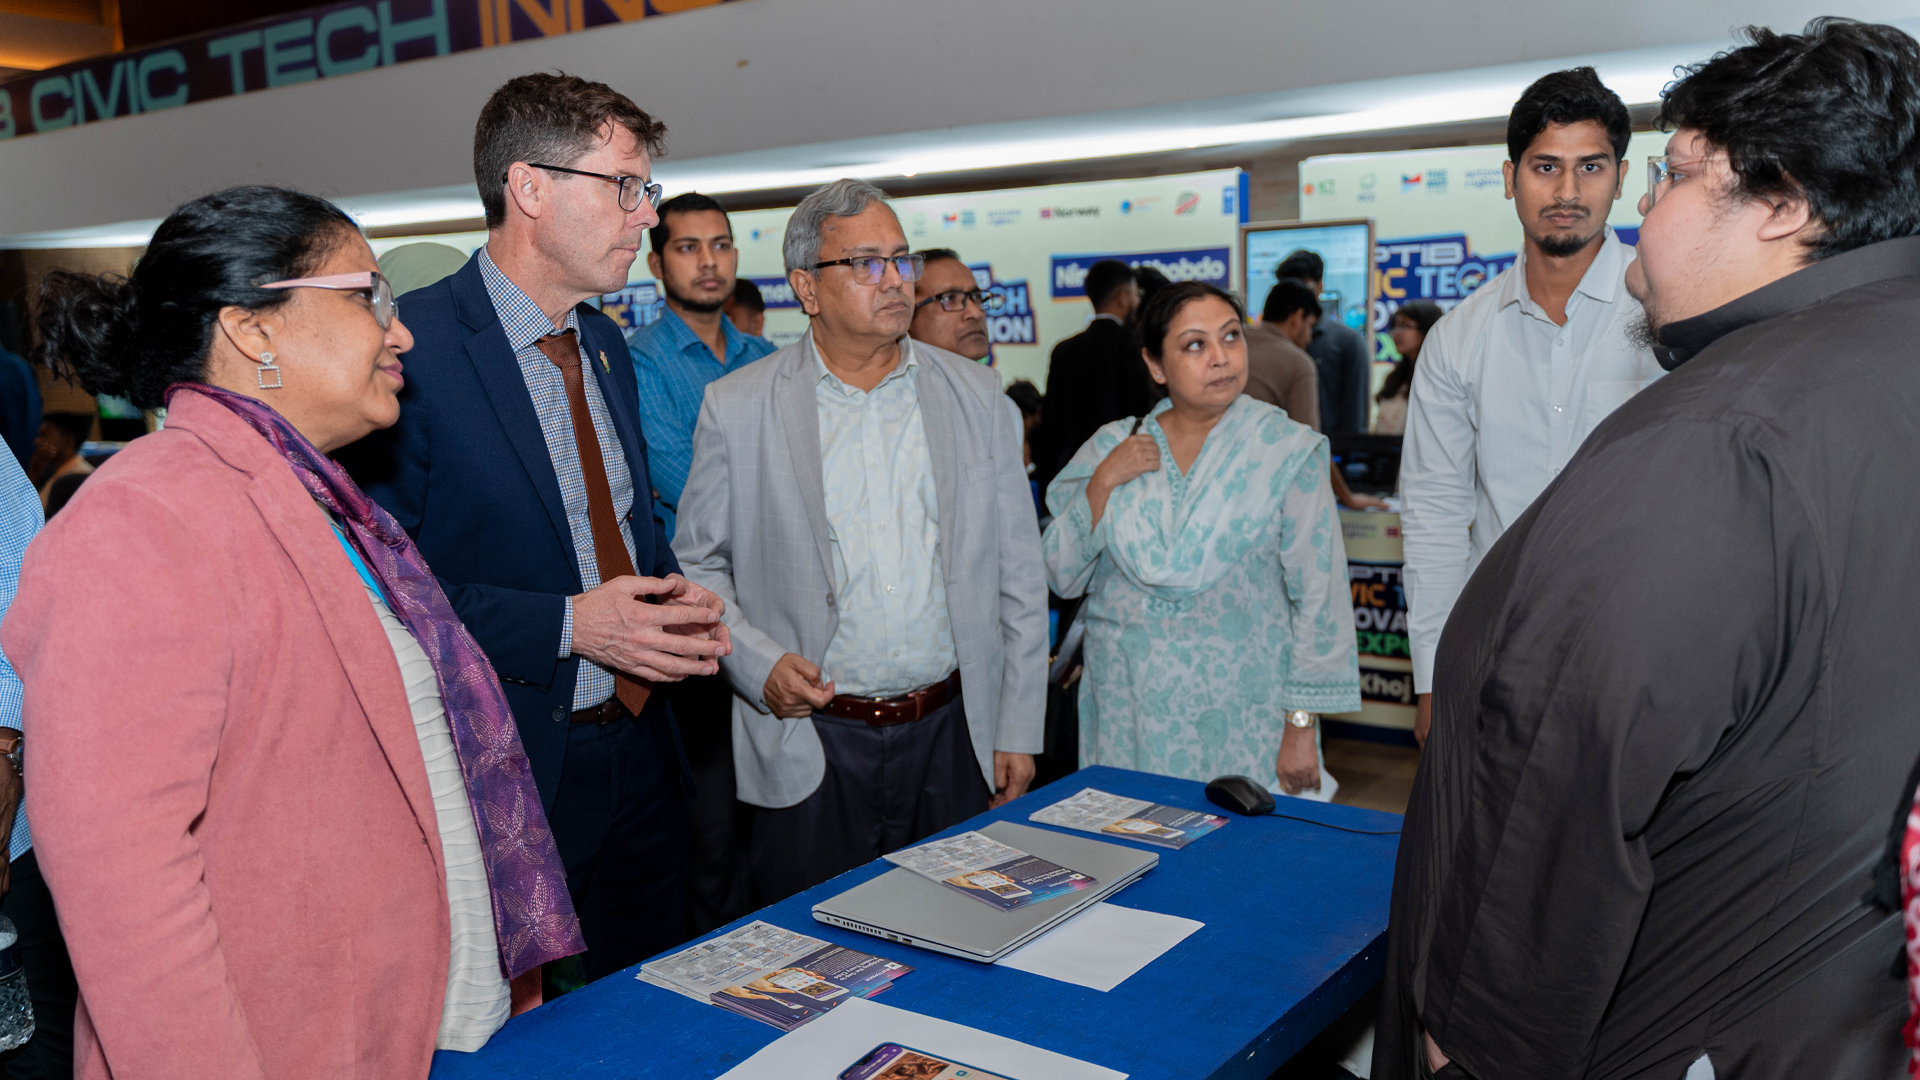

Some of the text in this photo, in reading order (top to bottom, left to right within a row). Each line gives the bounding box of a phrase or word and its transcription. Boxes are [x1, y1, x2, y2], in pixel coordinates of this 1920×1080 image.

[31, 49, 189, 133] CIVIC
[207, 0, 450, 95] TECH
[1348, 566, 1404, 584] PTI
